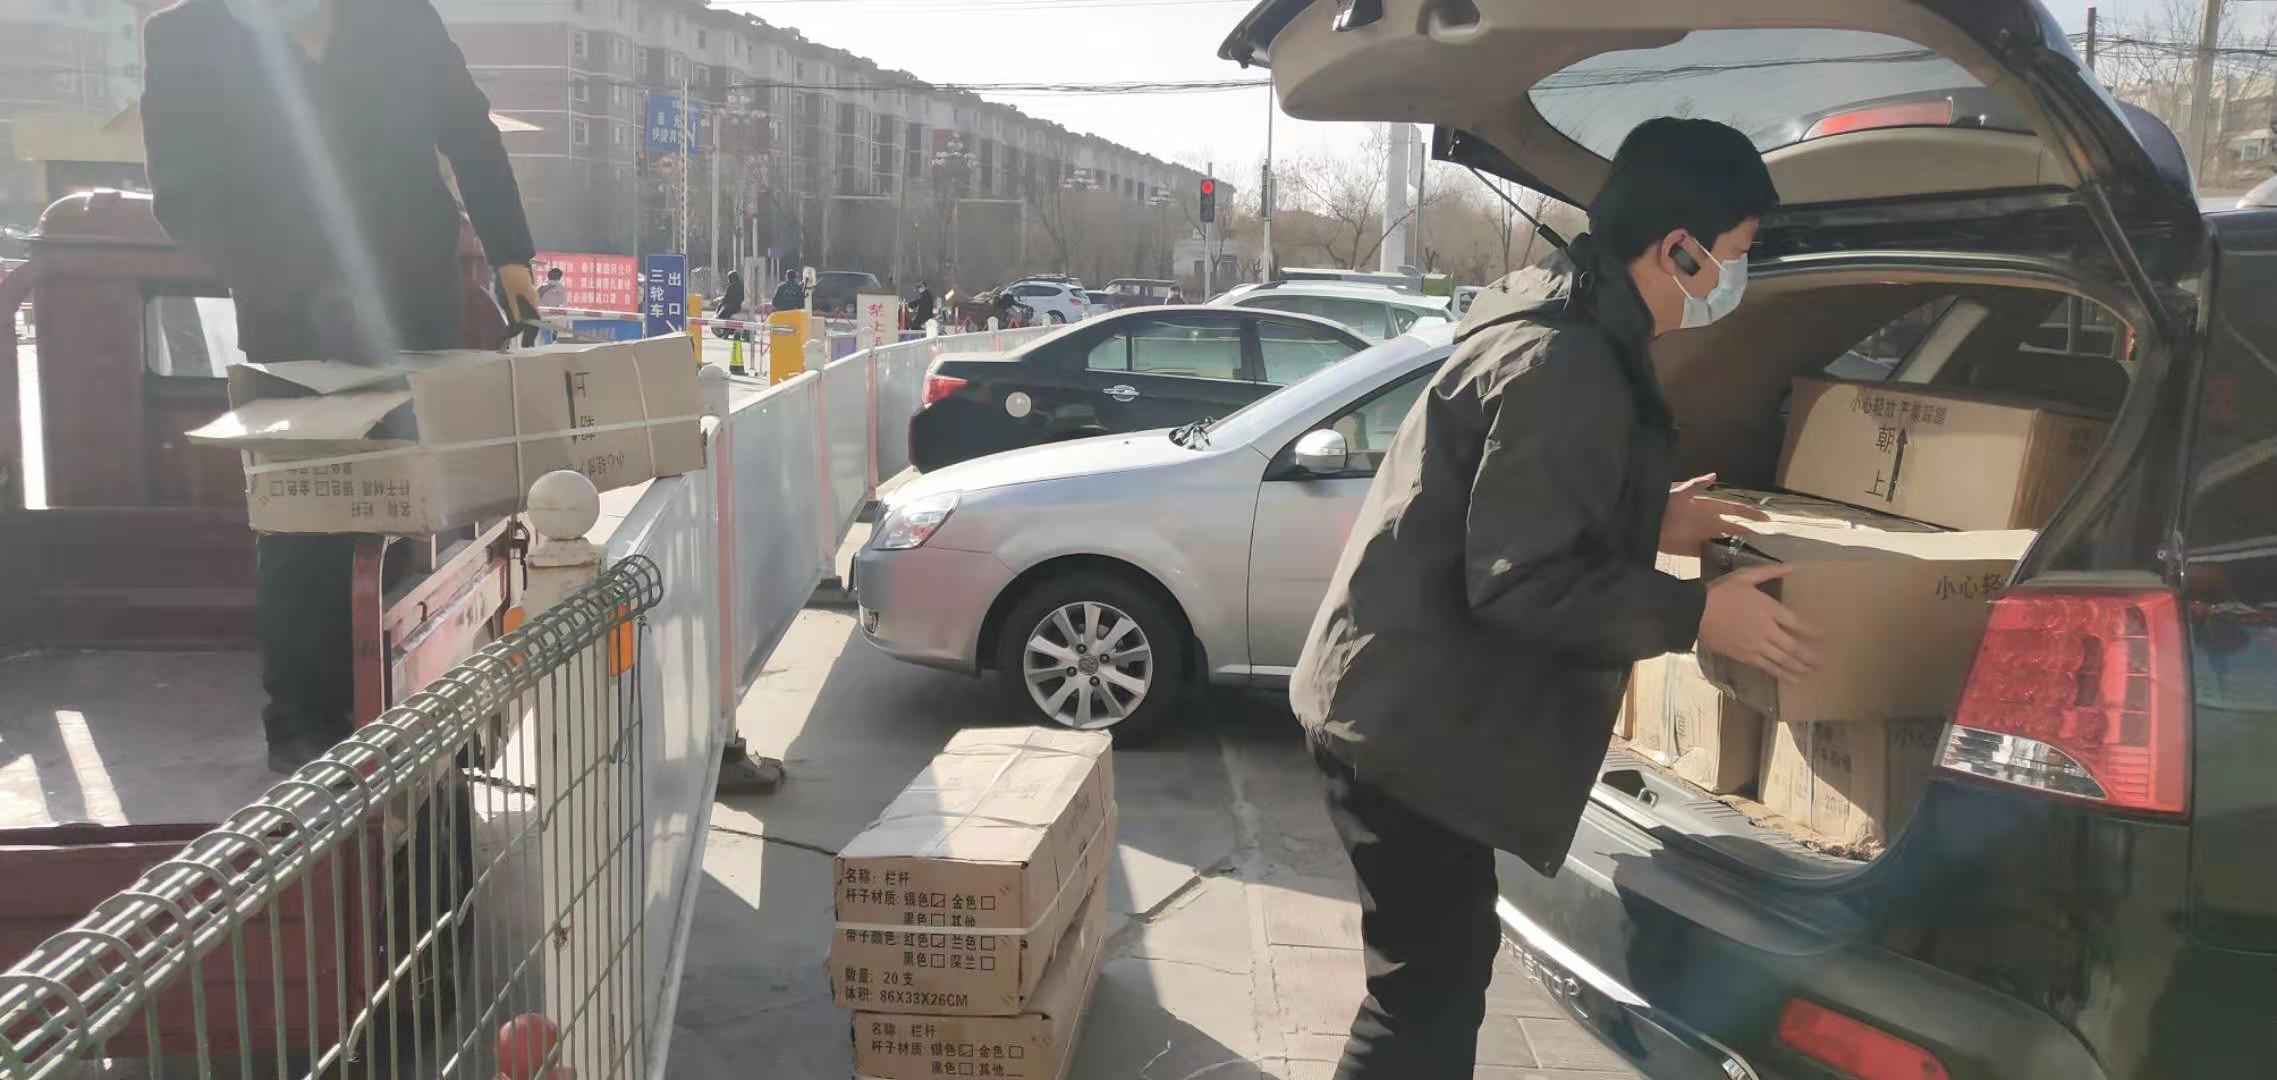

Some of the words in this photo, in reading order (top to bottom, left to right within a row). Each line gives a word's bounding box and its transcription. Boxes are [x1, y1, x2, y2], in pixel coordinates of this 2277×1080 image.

[650, 269, 664, 319] 三轮车
[668, 272, 682, 316] 出口
[885, 870, 911, 887] 栏杆
[904, 890, 929, 908] 银色
[952, 894, 977, 910] 金色
[904, 912, 928, 925] 黑色
[952, 914, 976, 927] 其他
[904, 932, 929, 948] 红色
[952, 935, 977, 951] 兰色
[904, 951, 928, 968] 黑色
[950, 954, 976, 971] 深兰
[883, 971, 899, 985] 20
[880, 990, 969, 1008] 86X33X26CM
[911, 1024, 937, 1040] 栏杆
[930, 1043, 957, 1057] 银色
[978, 1044, 1005, 1059] 金色
[930, 1062, 957, 1076] 黑色
[978, 1063, 1005, 1077] 其他
